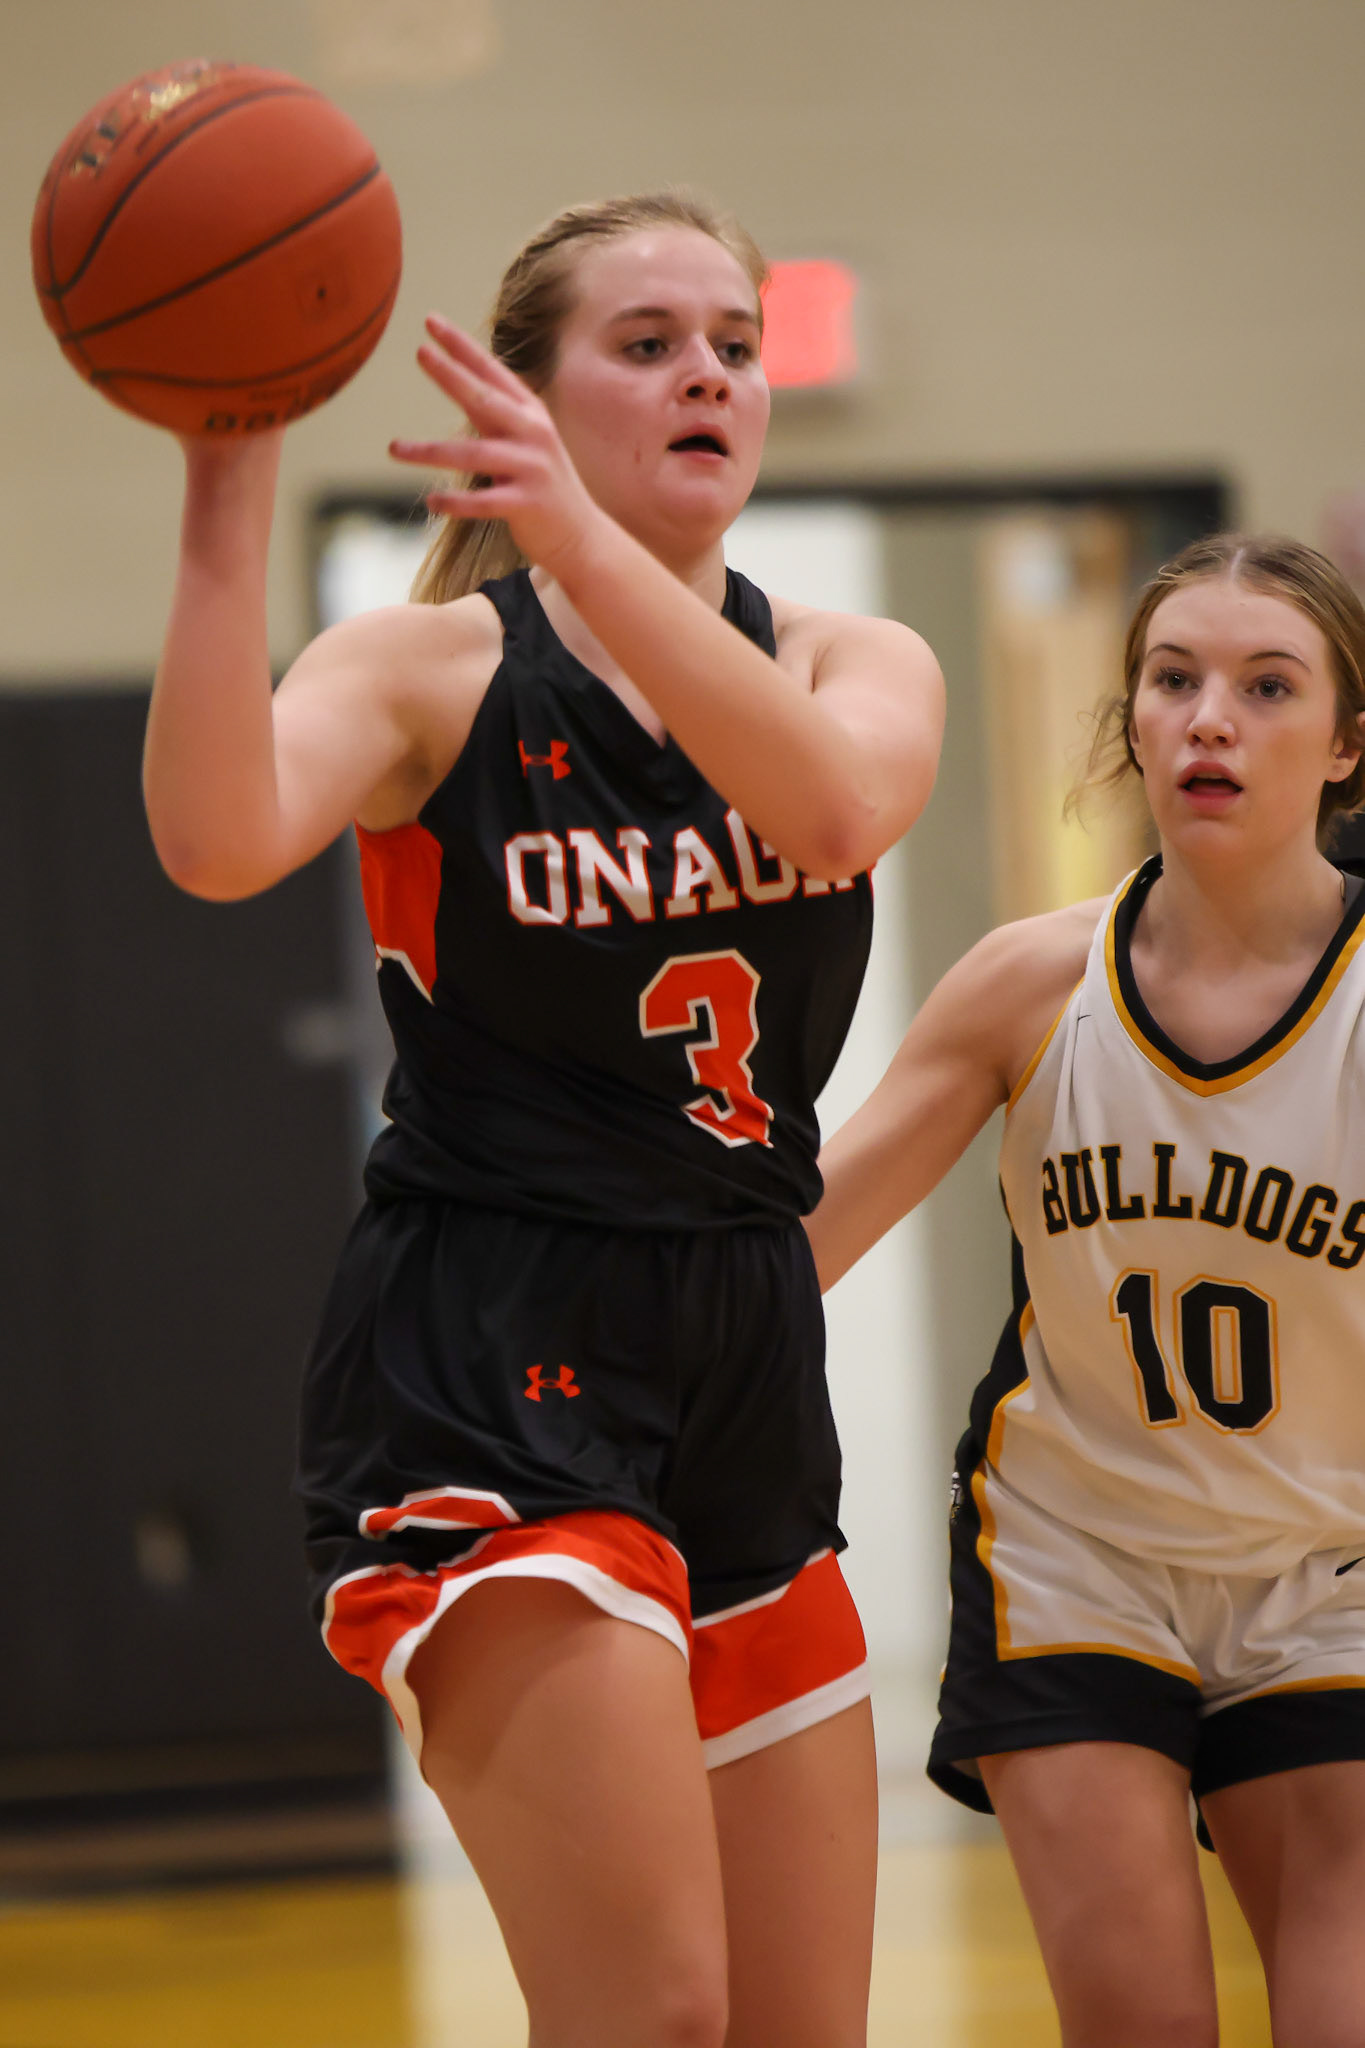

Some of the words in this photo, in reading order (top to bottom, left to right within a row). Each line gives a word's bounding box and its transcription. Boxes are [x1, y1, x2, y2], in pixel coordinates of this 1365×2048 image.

[504, 806, 856, 928] ONAG
[638, 948, 775, 1149] 3
[1041, 1142, 1365, 1271] BULLDOGS
[1108, 1266, 1282, 1437] 10
